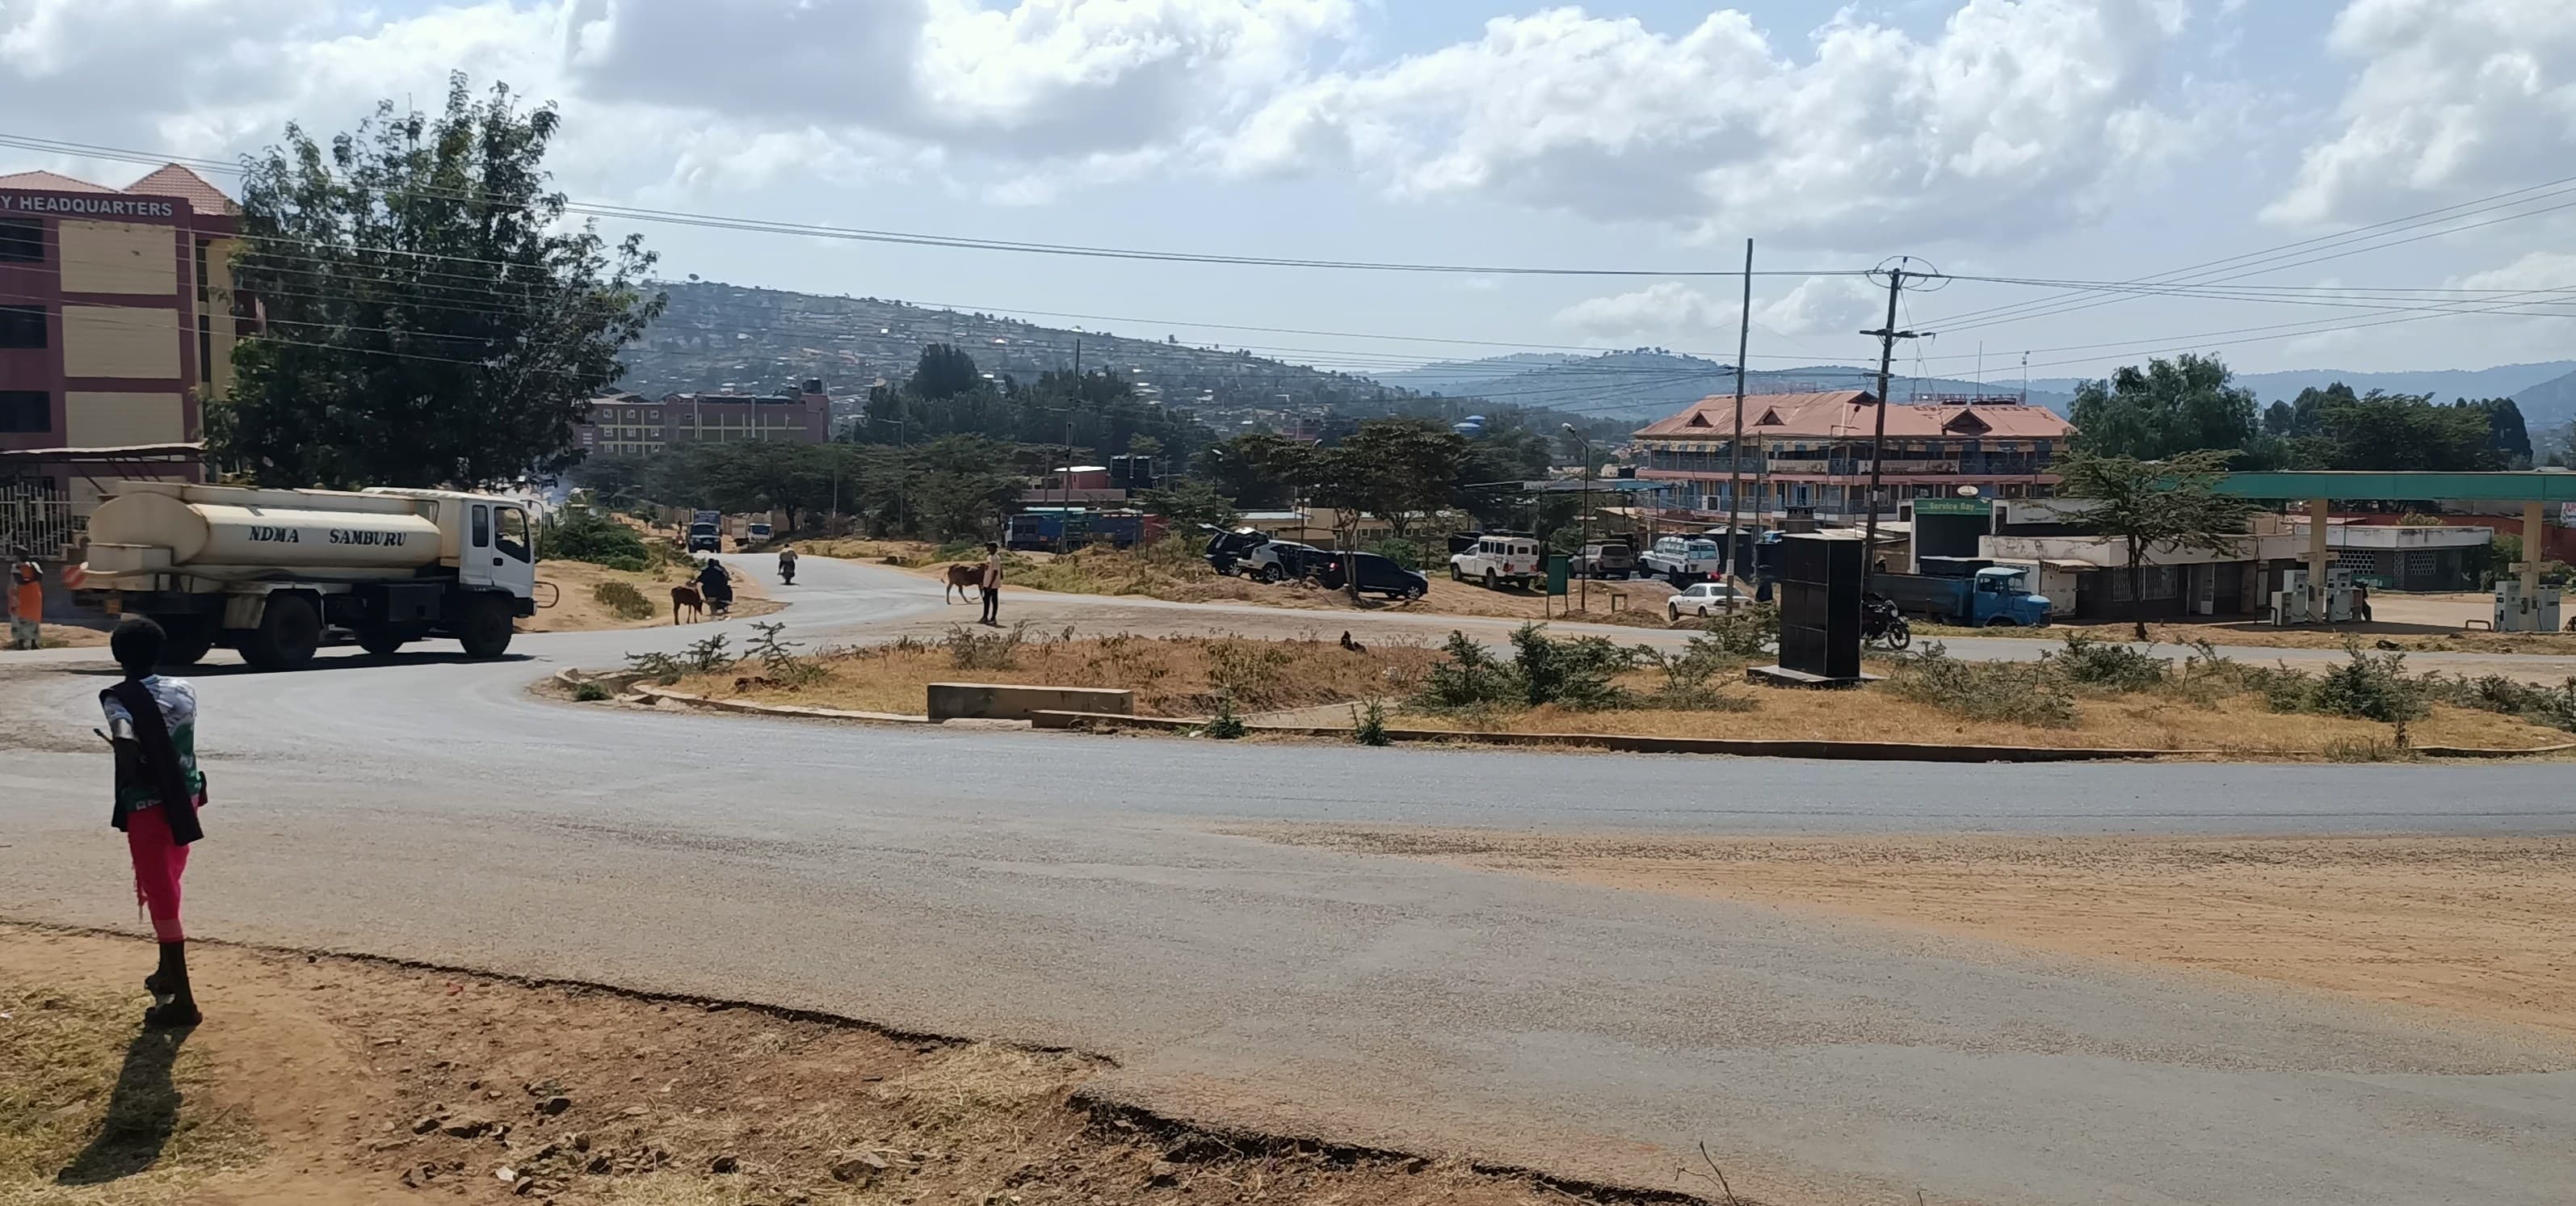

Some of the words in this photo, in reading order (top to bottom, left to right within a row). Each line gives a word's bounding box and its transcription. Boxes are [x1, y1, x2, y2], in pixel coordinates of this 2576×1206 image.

[19, 196, 173, 216] HEADQUARTERS
[1930, 502, 1957, 511] Service
[1960, 502, 1975, 511] Bay
[249, 526, 300, 543] NDMA
[329, 528, 407, 547] SAMBURU
